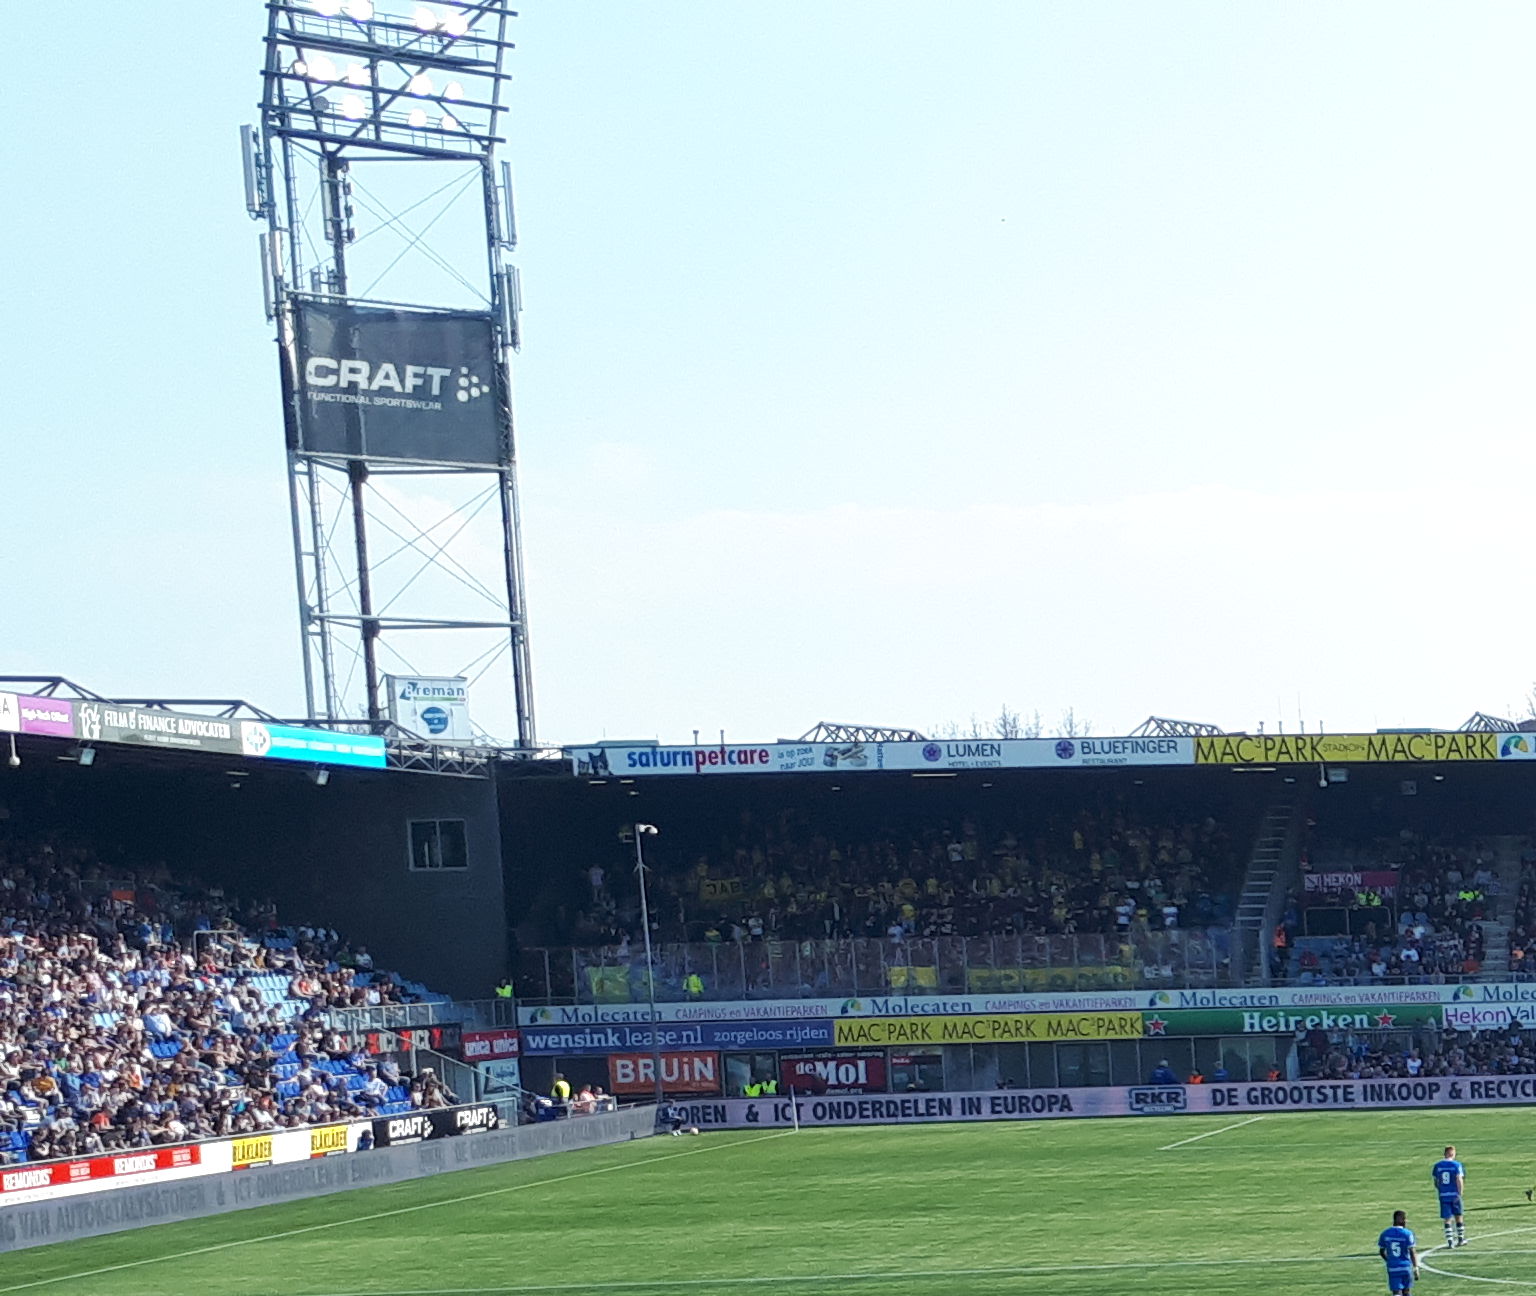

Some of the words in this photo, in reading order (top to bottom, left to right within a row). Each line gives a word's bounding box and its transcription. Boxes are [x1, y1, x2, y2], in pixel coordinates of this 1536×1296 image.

[305, 356, 452, 396] CRAFT
[307, 392, 370, 406] FUNCTIONAL
[373, 394, 442, 411] SPORTSWEAR
[404, 682, 465, 697] Breman
[104, 710, 129, 729] FIRM
[137, 714, 177, 735] FINANCE
[178, 718, 231, 740] ADVOCATEN
[946, 743, 1001, 758] LUMEN
[1081, 739, 1178, 755] BLUEFINGER
[627, 745, 770, 775] saturnpetcare
[1323, 873, 1362, 887] HEKON
[871, 998, 972, 1015] Molecaten
[985, 1000, 1037, 1012] CAMPINGS
[1053, 996, 1137, 1011] VAKANTIEPARKEN
[1178, 991, 1280, 1008] Molecaten
[1291, 993, 1342, 1005] CAMPINGS
[1358, 990, 1441, 1004] VAKANTIEPARKEN
[675, 1009, 727, 1020] CAMPINGS
[742, 1004, 828, 1019] VAKANTIEPARKEN
[1242, 1010, 1369, 1033] Heineken
[713, 1027, 783, 1045] zorgeloos
[785, 1026, 829, 1043] rijden
[745, 1103, 759, 1122] &
[774, 1102, 801, 1121] ICT
[812, 1096, 952, 1120] ONDERDELEN
[961, 1096, 983, 1115] IN
[990, 1093, 1073, 1114] EUROPA
[1133, 1089, 1180, 1105] RKR
[1212, 1087, 1239, 1106] DE
[1247, 1083, 1355, 1105] GROOTSTE
[1363, 1081, 1441, 1101] INKOOP
[1449, 1082, 1462, 1099] &
[388, 1116, 424, 1139] CRAFT
[457, 1107, 489, 1130] CRAFT
[1391, 1241, 1402, 1258] 5
